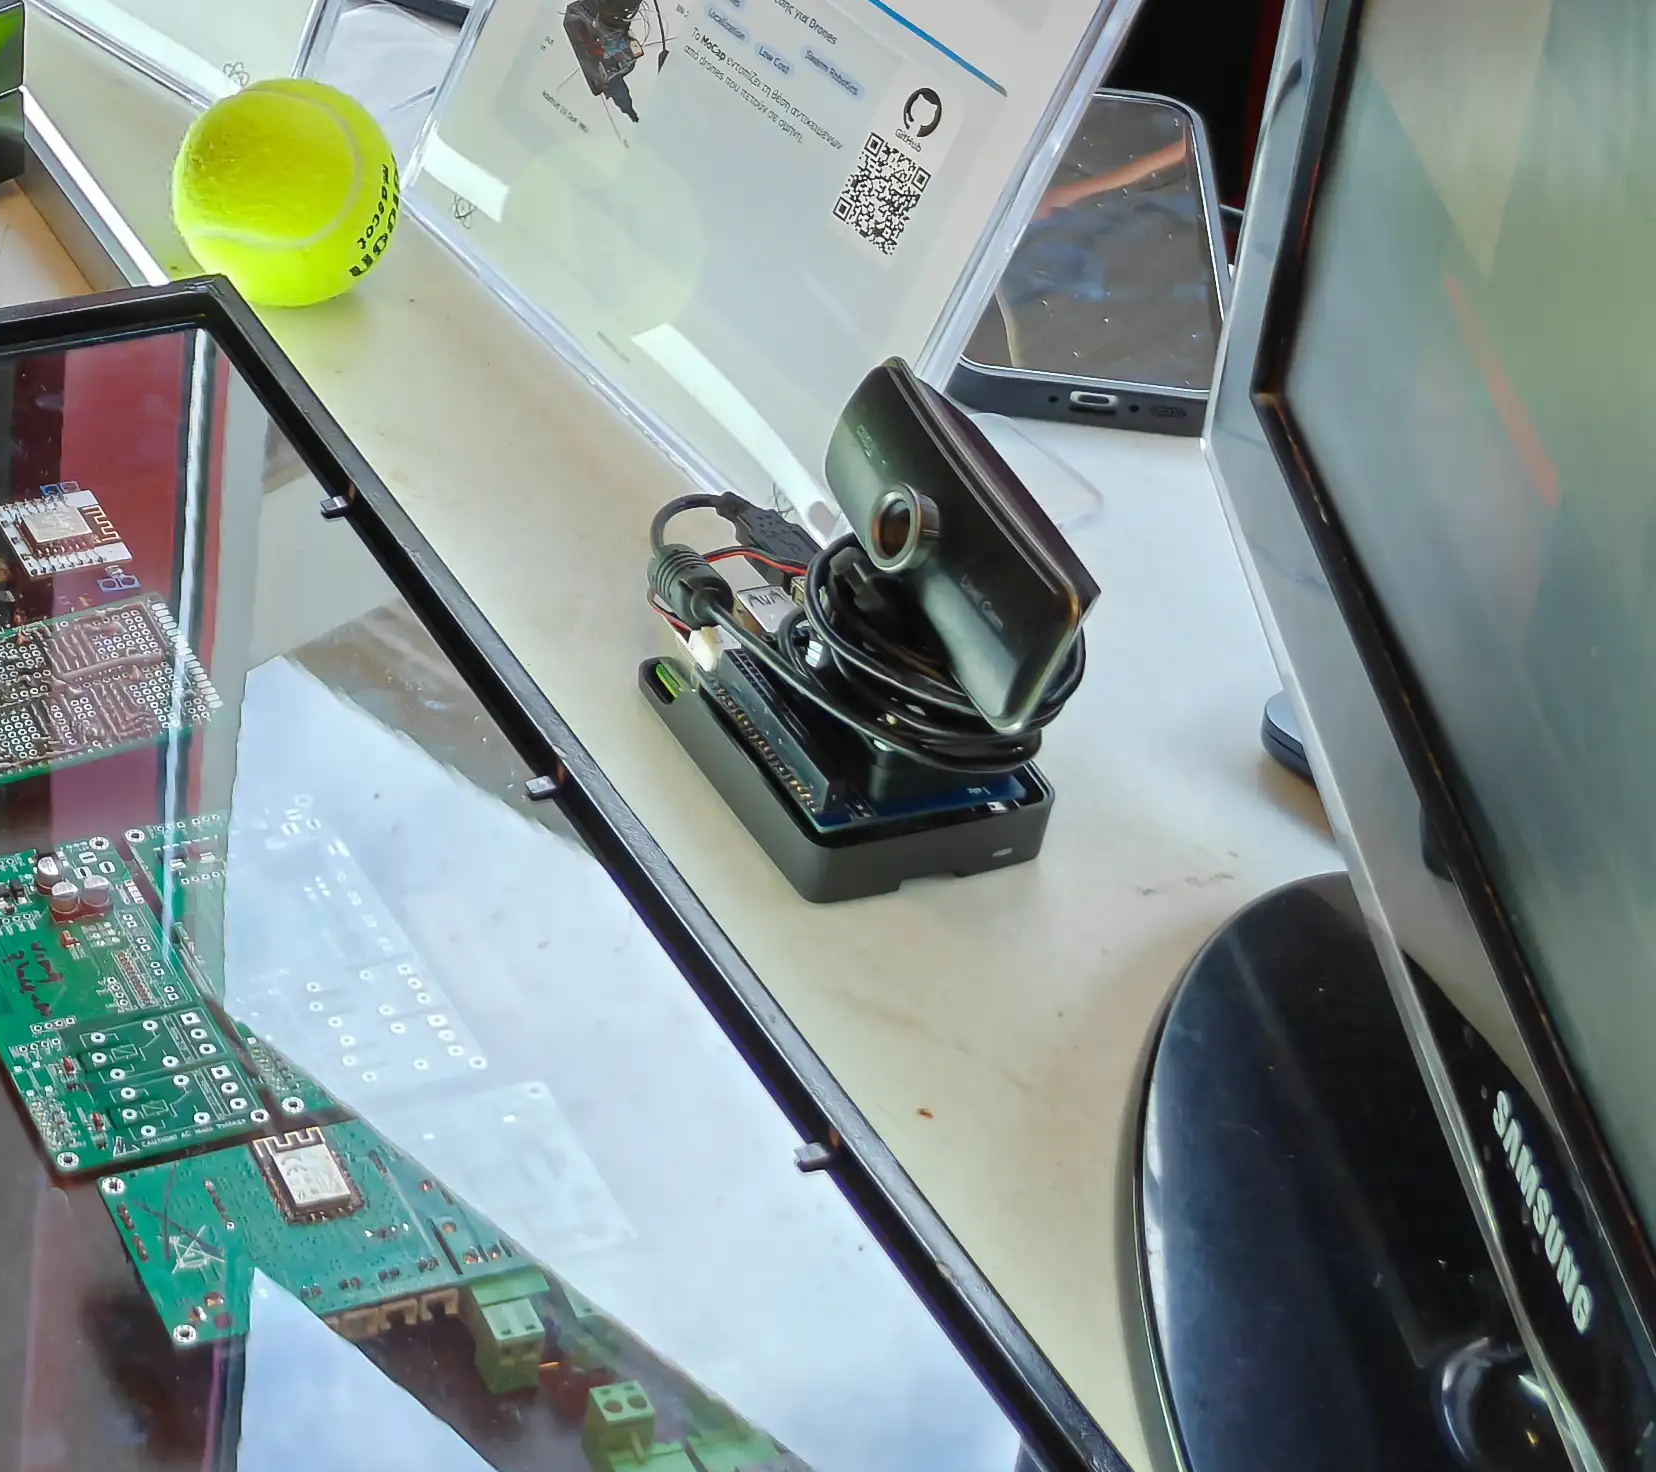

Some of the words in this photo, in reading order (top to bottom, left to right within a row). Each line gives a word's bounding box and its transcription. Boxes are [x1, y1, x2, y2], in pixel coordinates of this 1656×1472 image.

[809, 18, 837, 44] Drones
[701, 35, 726, 60] MoCap
[699, 57, 724, 80] drones
[895, 129, 921, 152] GitHub
[1492, 1090, 1594, 1334] SAMSUNG
